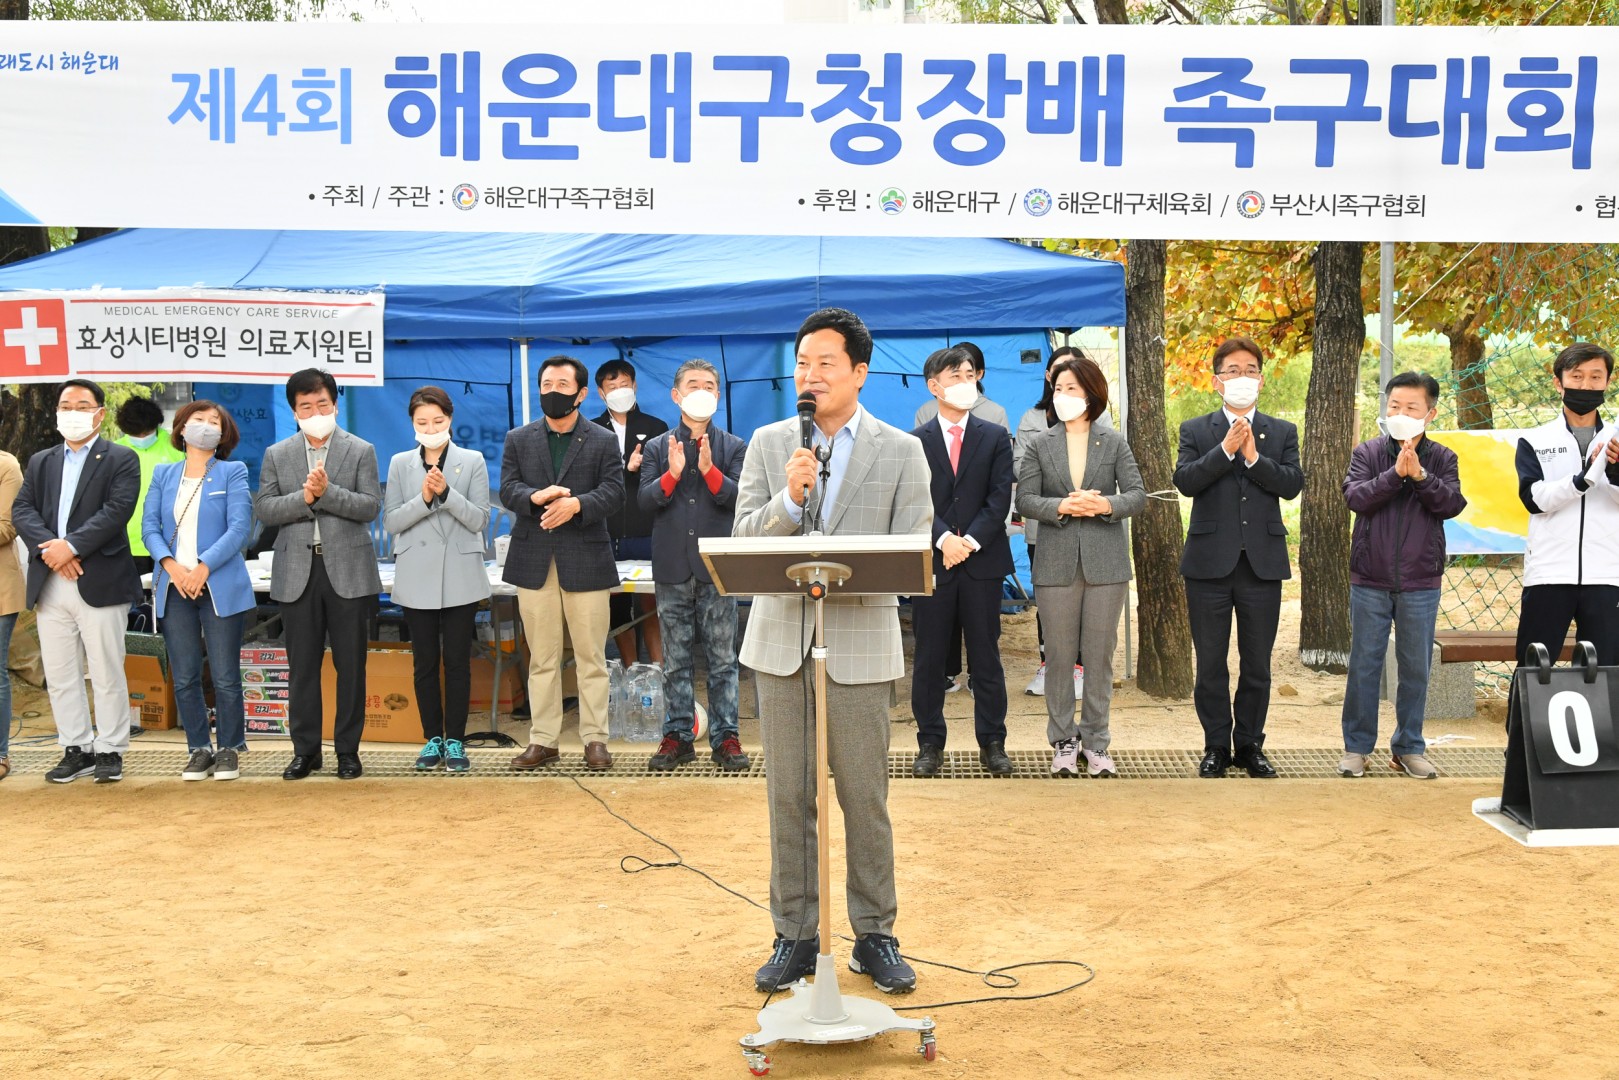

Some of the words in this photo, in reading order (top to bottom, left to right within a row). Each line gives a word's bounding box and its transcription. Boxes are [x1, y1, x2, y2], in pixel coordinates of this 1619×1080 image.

[59, 51, 119, 75] 해운대
[167, 66, 352, 145] 제4회
[384, 50, 1126, 168] 해운대구청장배
[1163, 55, 1599, 170] 족구대회
[322, 185, 364, 207] 주최
[483, 185, 654, 211] 해운대구족구협회
[812, 188, 857, 212] 후원
[912, 190, 1001, 213] 해운대구
[1057, 191, 1212, 216] 해운대구체육회
[1269, 193, 1426, 218] 부산시족구협회
[1594, 195, 1619, 218] 협
[103, 305, 159, 316] MEDICAL
[164, 305, 240, 316] EMERGENCY
[246, 307, 280, 317] CARE
[285, 308, 339, 319] SERVICE
[76, 325, 227, 359] 효성시티병원
[238, 328, 373, 364] 의료지원팀
[1535, 447, 1556, 455] PEOPLE
[1548, 691, 1599, 767] 0
